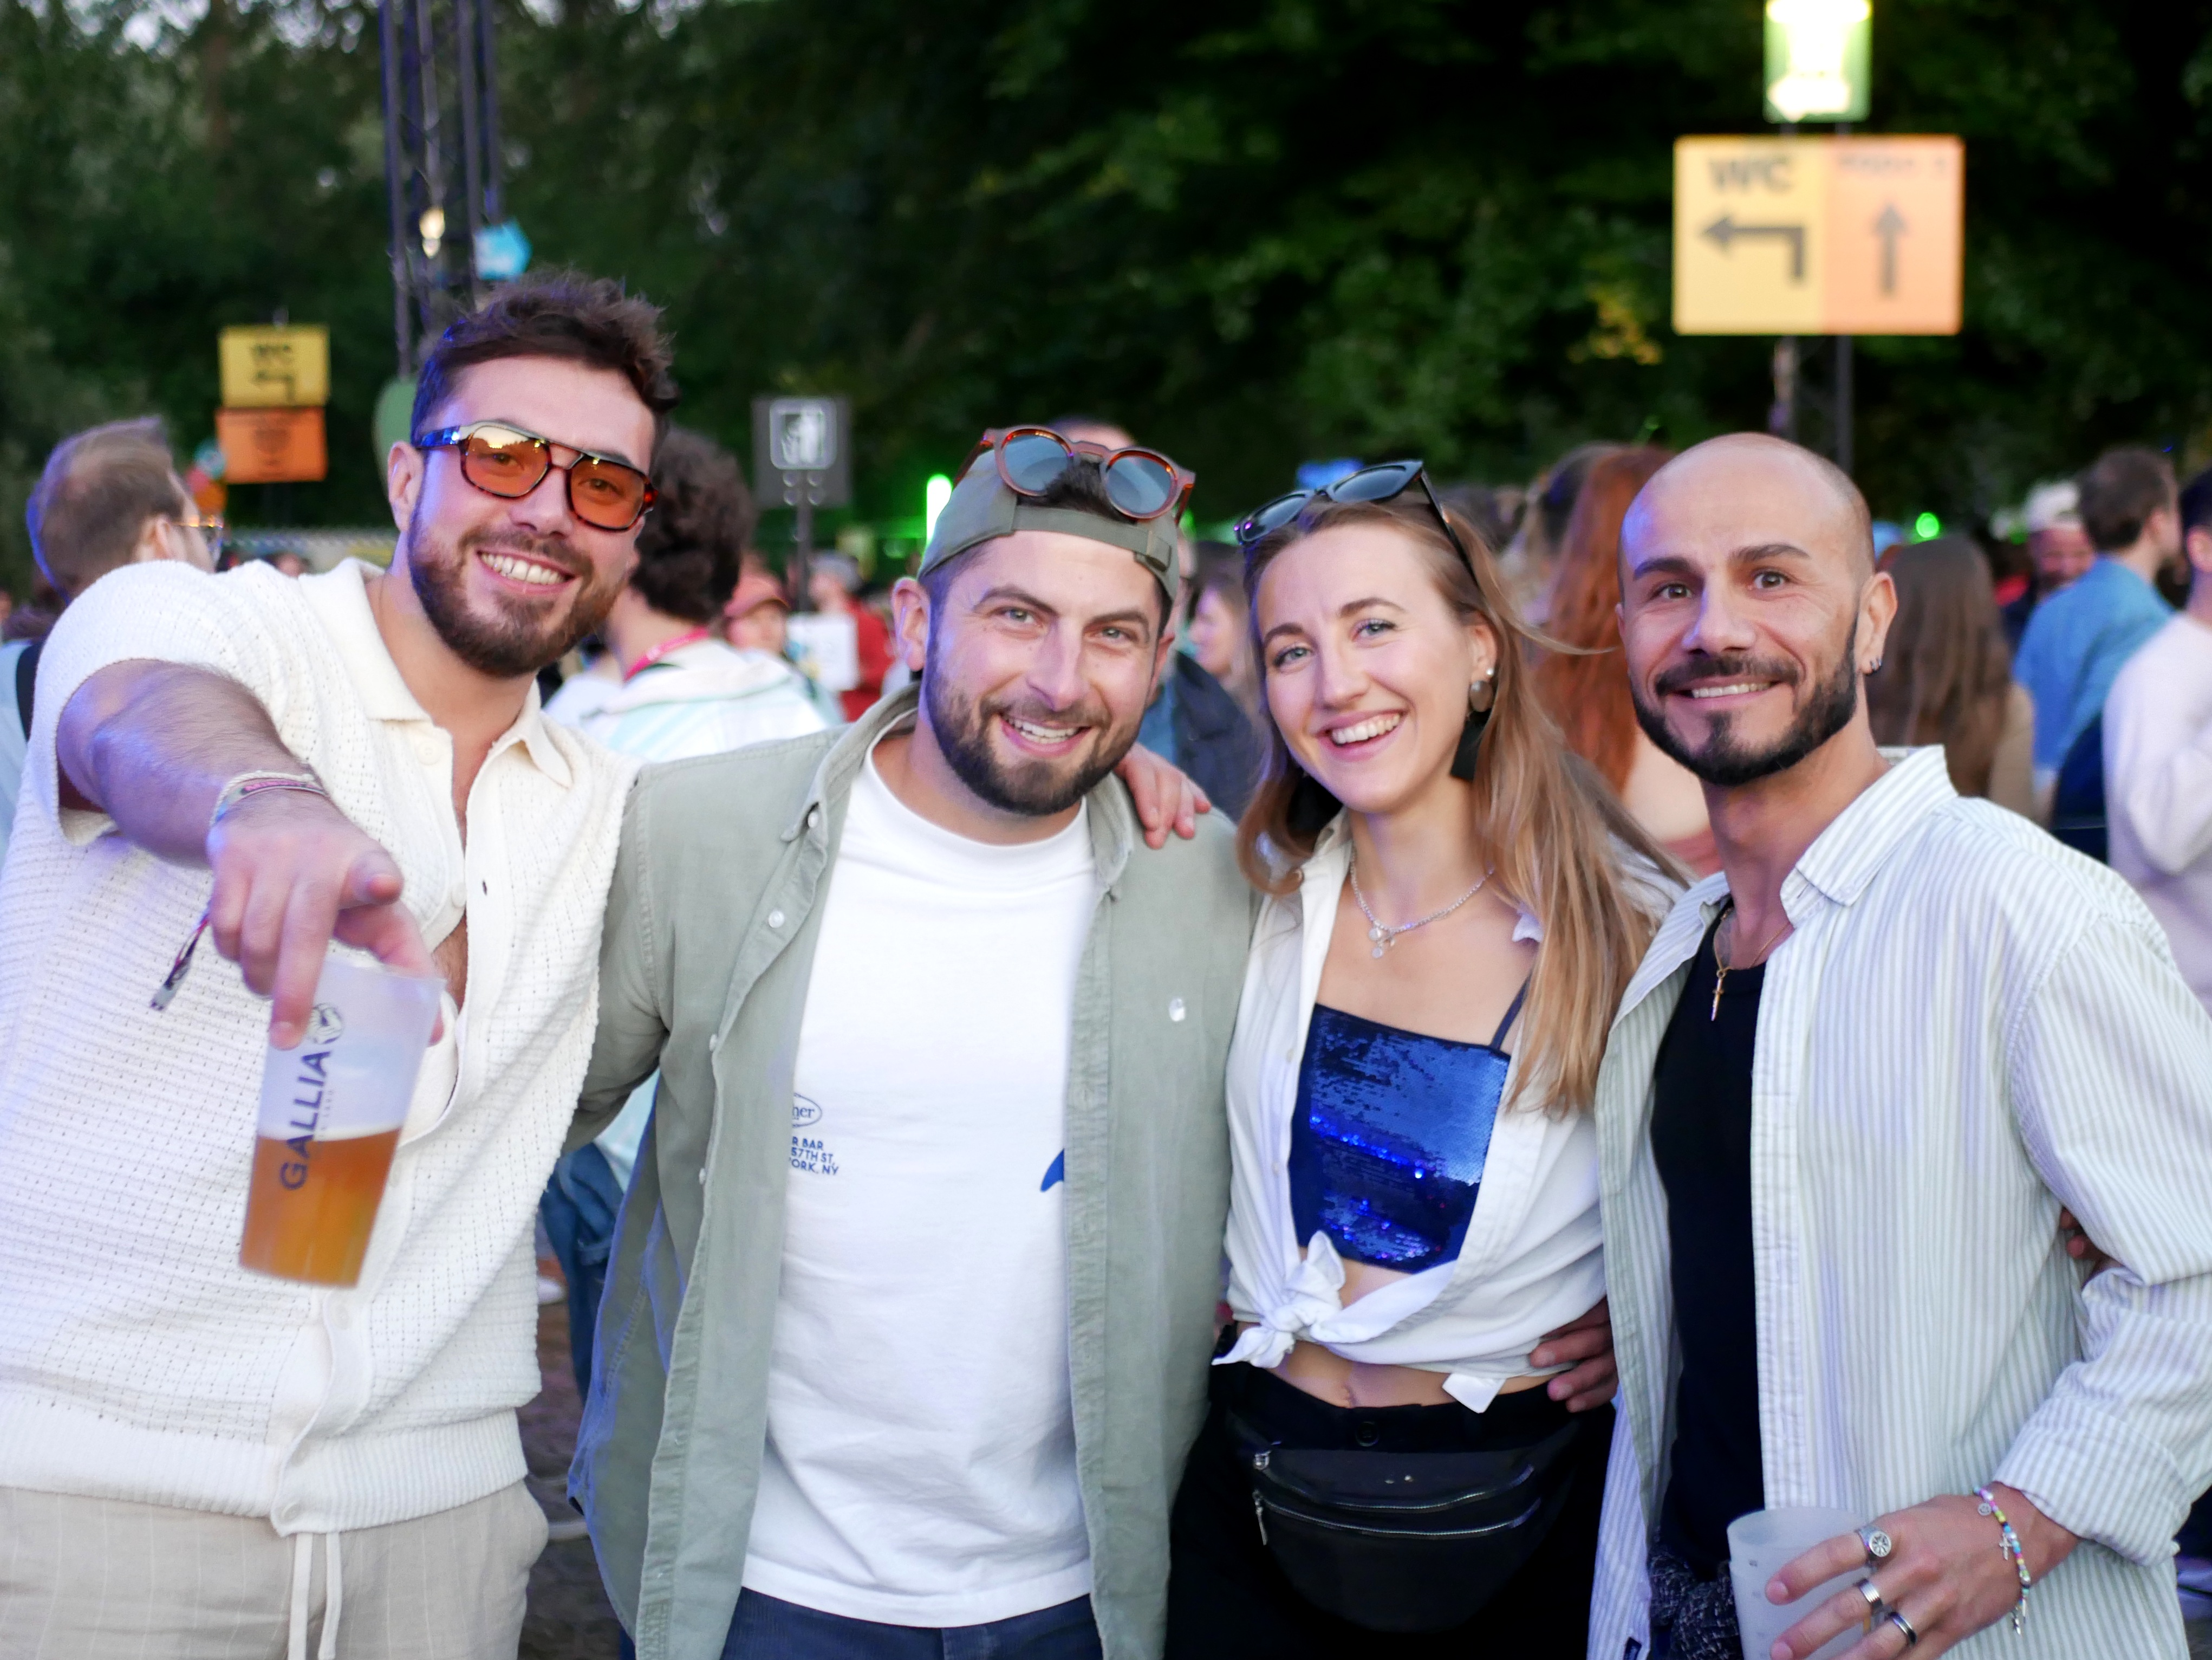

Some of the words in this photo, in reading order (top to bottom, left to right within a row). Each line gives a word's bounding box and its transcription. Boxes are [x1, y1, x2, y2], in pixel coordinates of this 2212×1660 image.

[1708, 155, 1794, 193] WC
[279, 1051, 331, 1190] GALLIA
[802, 1138, 823, 1150] BAR
[791, 1147, 818, 1161] 57TH
[822, 1164, 839, 1175] NY
